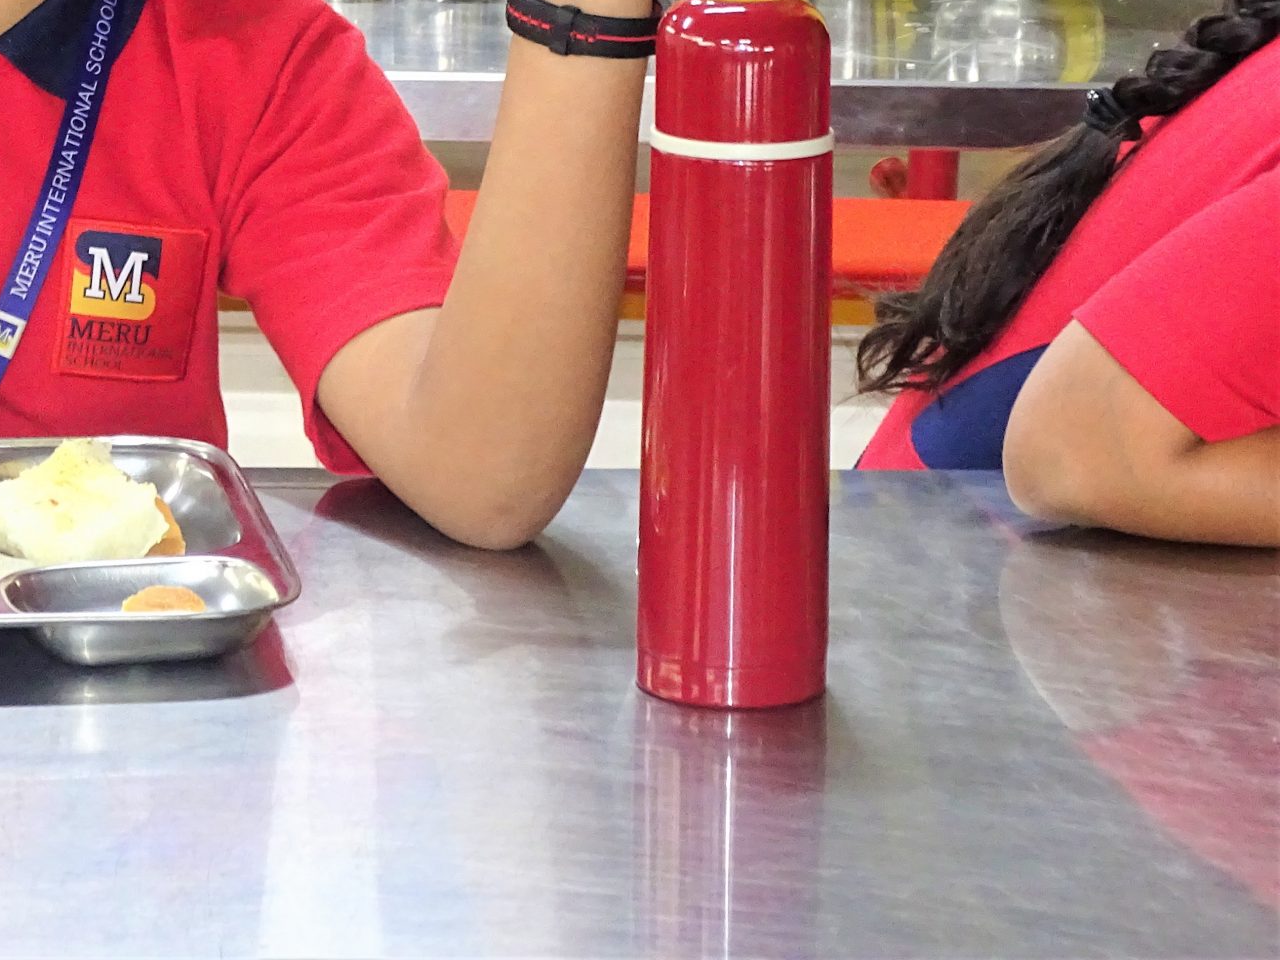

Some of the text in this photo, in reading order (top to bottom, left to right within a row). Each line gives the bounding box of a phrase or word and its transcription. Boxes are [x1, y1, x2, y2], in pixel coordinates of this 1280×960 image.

[10, 237, 47, 300] MERU
[40, 80, 98, 237] INTERNATIONAL
[83, 246, 150, 304] M
[69, 317, 152, 345] MERU
